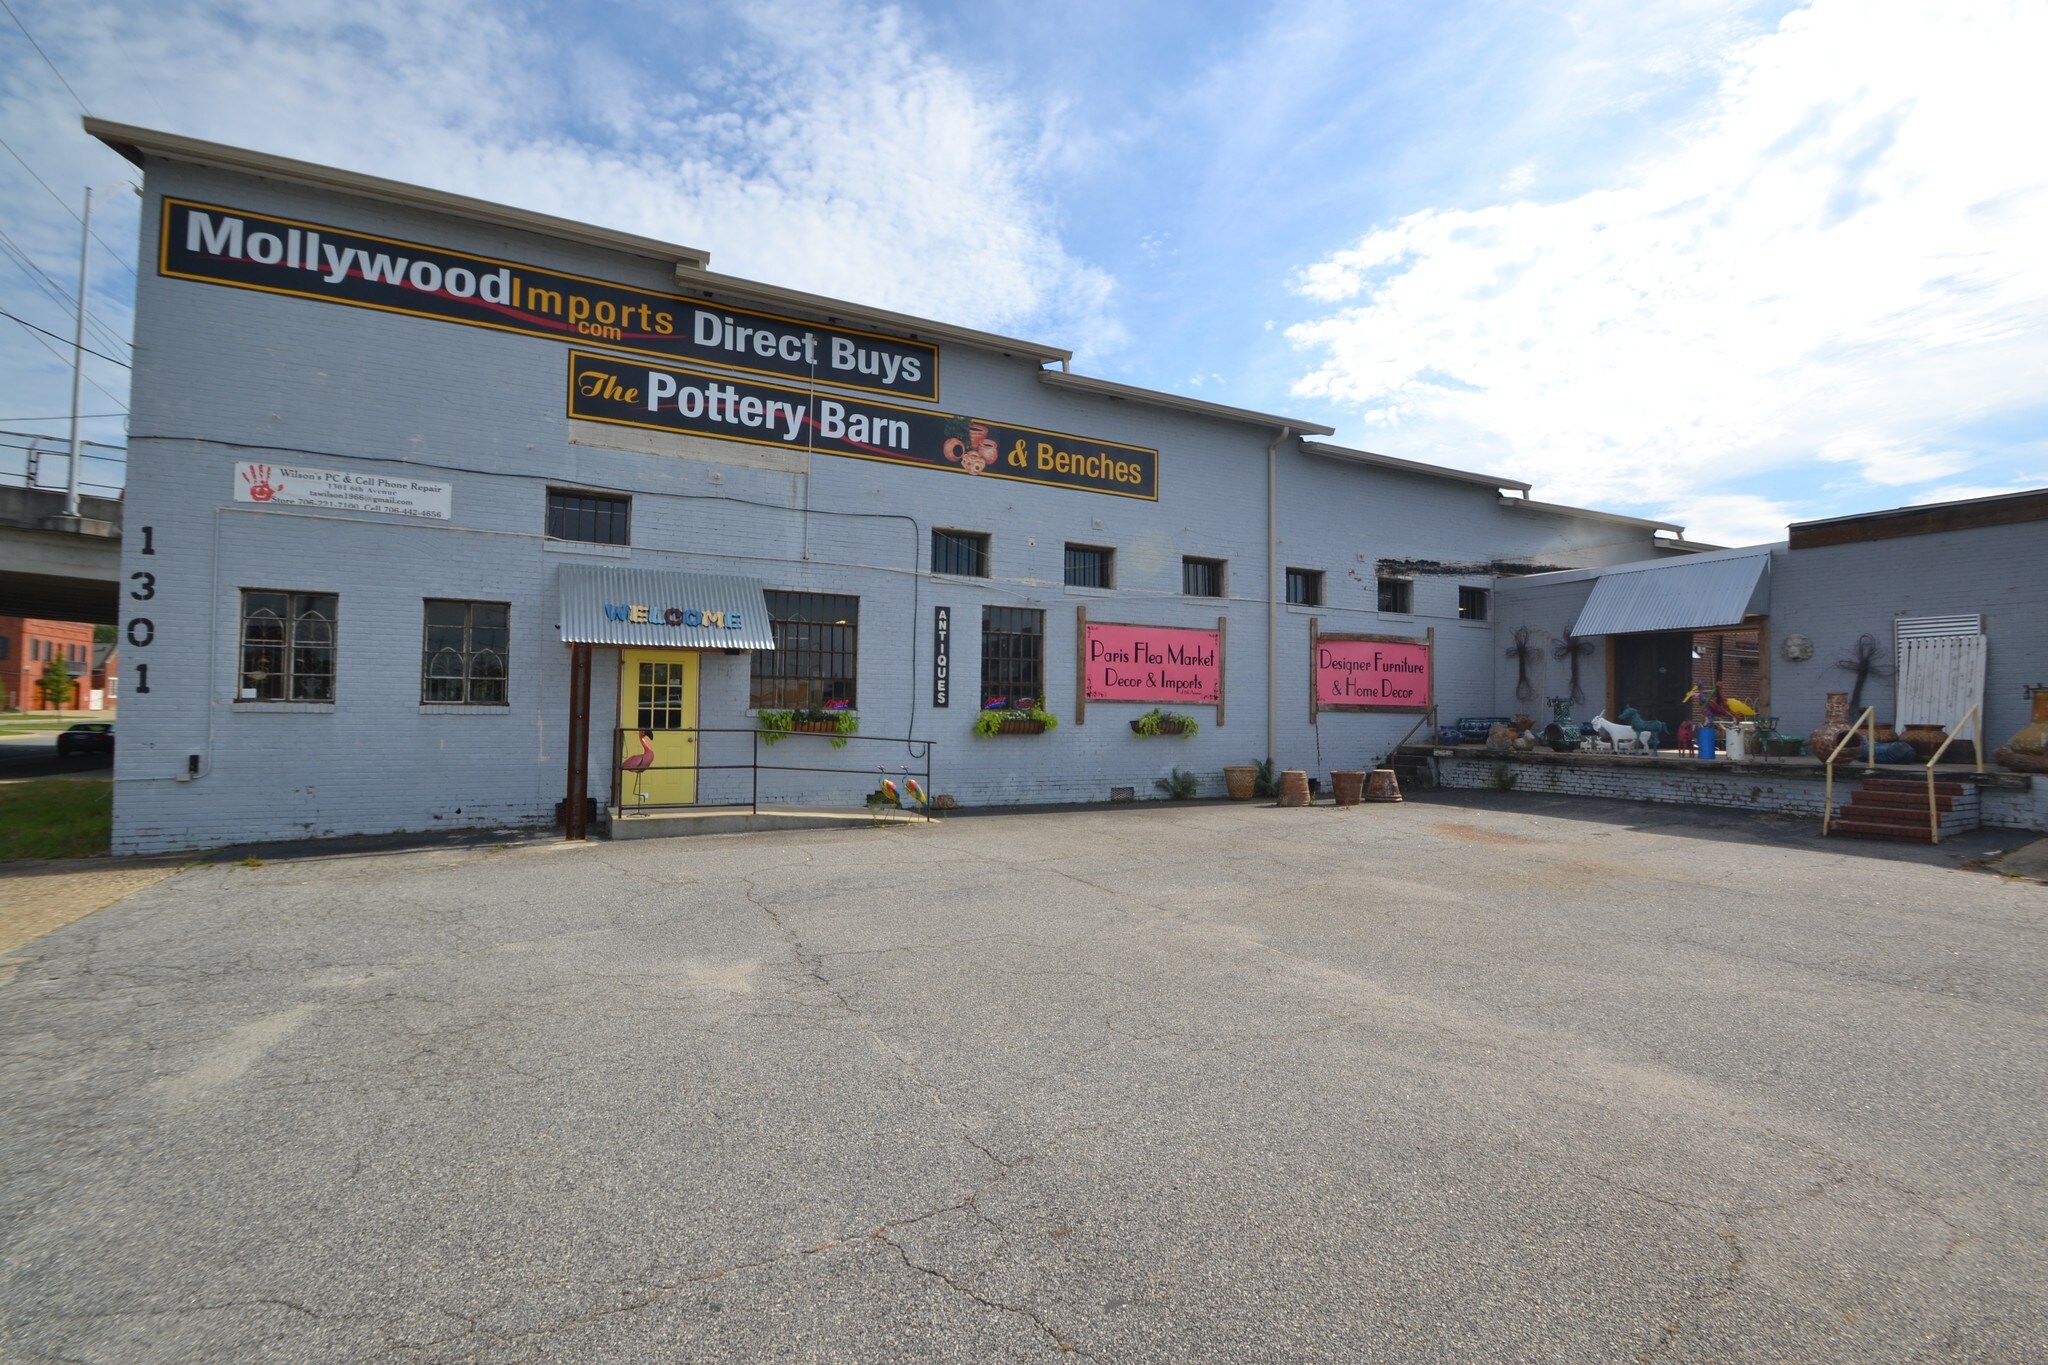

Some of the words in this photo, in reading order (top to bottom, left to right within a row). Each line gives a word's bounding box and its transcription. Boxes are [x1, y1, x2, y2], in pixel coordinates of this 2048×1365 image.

[694, 310, 817, 366] Direct
[831, 336, 922, 385] Buys
[578, 370, 640, 403] The
[647, 371, 806, 442] Pottery
[820, 400, 910, 450] Barn
[1007, 439, 1028, 468] &
[1037, 442, 1142, 485] Benches
[280, 468, 322, 481] Wilson's
[325, 473, 340, 483] PC
[343, 474, 352, 484] &
[355, 476, 375, 487] Cell
[378, 478, 408, 490] Phone
[410, 482, 442, 493] Repair
[350, 485, 364, 493] 6th
[368, 487, 397, 496] Avenue
[271, 495, 295, 505] Store
[364, 504, 381, 512] Cell
[127, 526, 156, 694] 1301
[604, 603, 742, 630] WELCOME
[937, 609, 948, 704] ANTIQUES
[1091, 639, 1130, 664] Paris
[1134, 641, 1163, 665] Flea
[1167, 643, 1214, 667] Market
[1320, 648, 1371, 675] Designer
[1374, 652, 1424, 674] Furniture
[1105, 667, 1142, 688] Decor
[1146, 672, 1157, 688] &
[1161, 670, 1202, 693] Imports
[1332, 679, 1342, 696] &
[1345, 677, 1378, 697] Home
[1381, 678, 1413, 698] Decor
